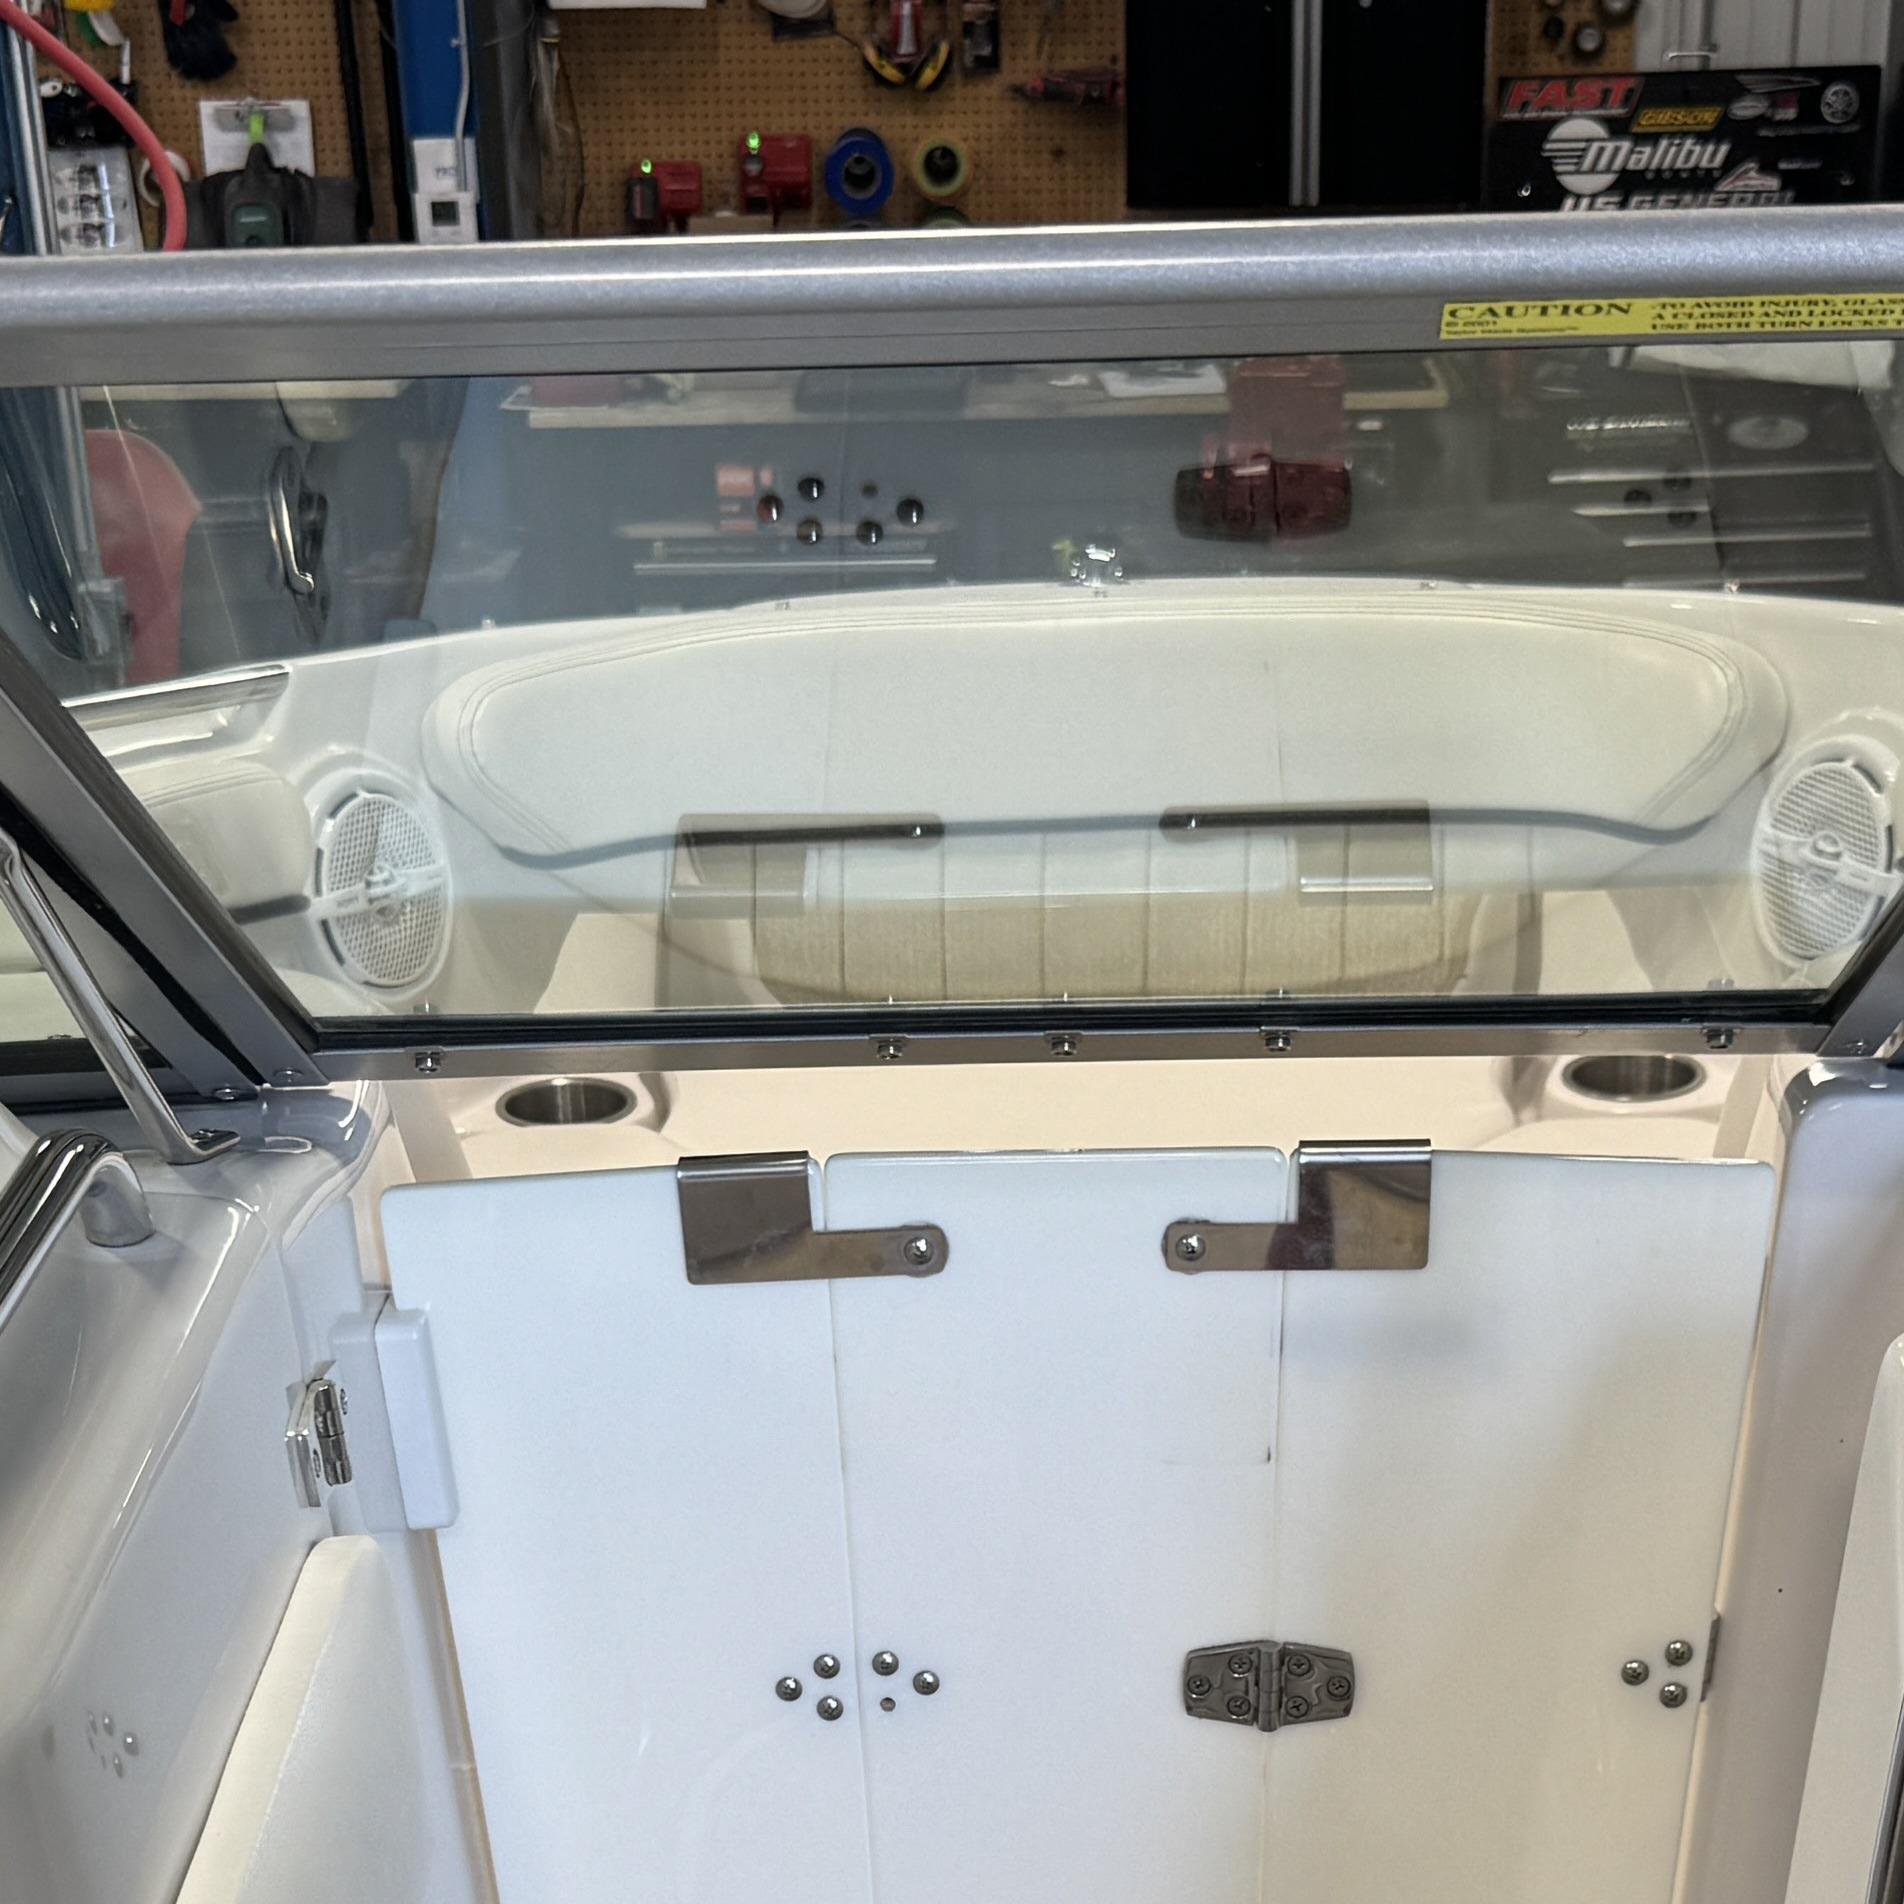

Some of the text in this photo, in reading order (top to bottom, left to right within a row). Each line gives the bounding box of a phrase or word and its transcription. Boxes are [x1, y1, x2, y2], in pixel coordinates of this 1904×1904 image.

[1506, 78, 1637, 109] FAST
[1579, 136, 1732, 172] Malibu
[1448, 302, 1632, 319] CAUTION
[1691, 301, 1753, 309] AVOID
[1762, 310, 1802, 318] AND
[1808, 308, 1895, 317] LOCKED
